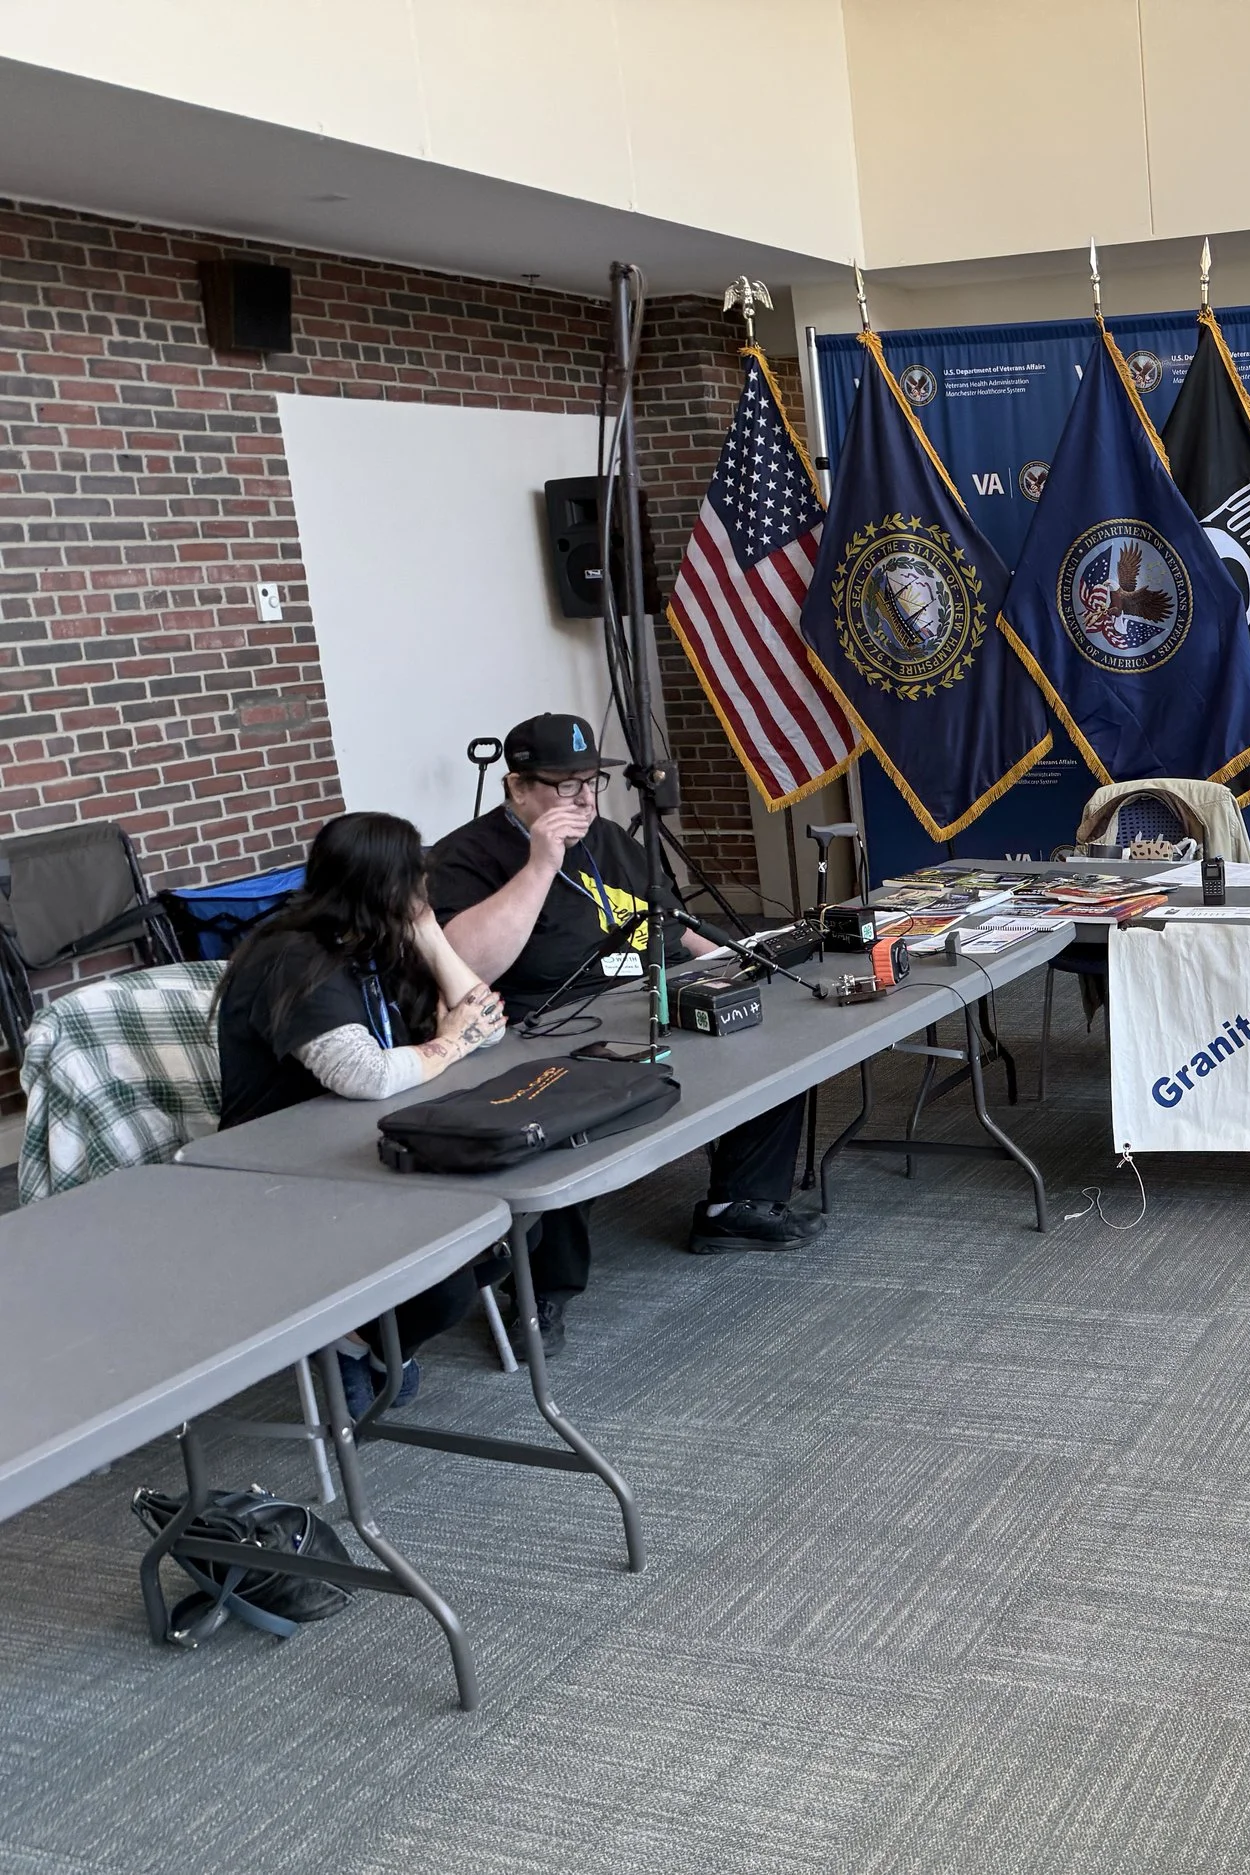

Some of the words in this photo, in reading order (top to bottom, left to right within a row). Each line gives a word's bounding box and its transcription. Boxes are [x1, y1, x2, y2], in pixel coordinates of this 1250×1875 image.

[956, 366, 992, 376] Department
[972, 473, 1004, 495] VA
[880, 540, 899, 556] THE
[1084, 526, 1153, 548] DEPARTMENT
[1154, 538, 1164, 550] OF
[864, 556, 876, 570] OF
[908, 543, 943, 568] STATE
[946, 575, 958, 591] OF
[1064, 557, 1079, 602] UNITED
[1164, 551, 1187, 611] VETERANS
[852, 578, 866, 608] SEAL
[954, 602, 964, 632] NEW
[1064, 607, 1086, 644] STATES
[861, 634, 884, 661] 1776
[1160, 616, 1185, 656] AFFAIRS
[900, 636, 958, 675] HAMPSHIRE
[1086, 645, 1100, 657] OF
[1101, 654, 1149, 668] AMERICA
